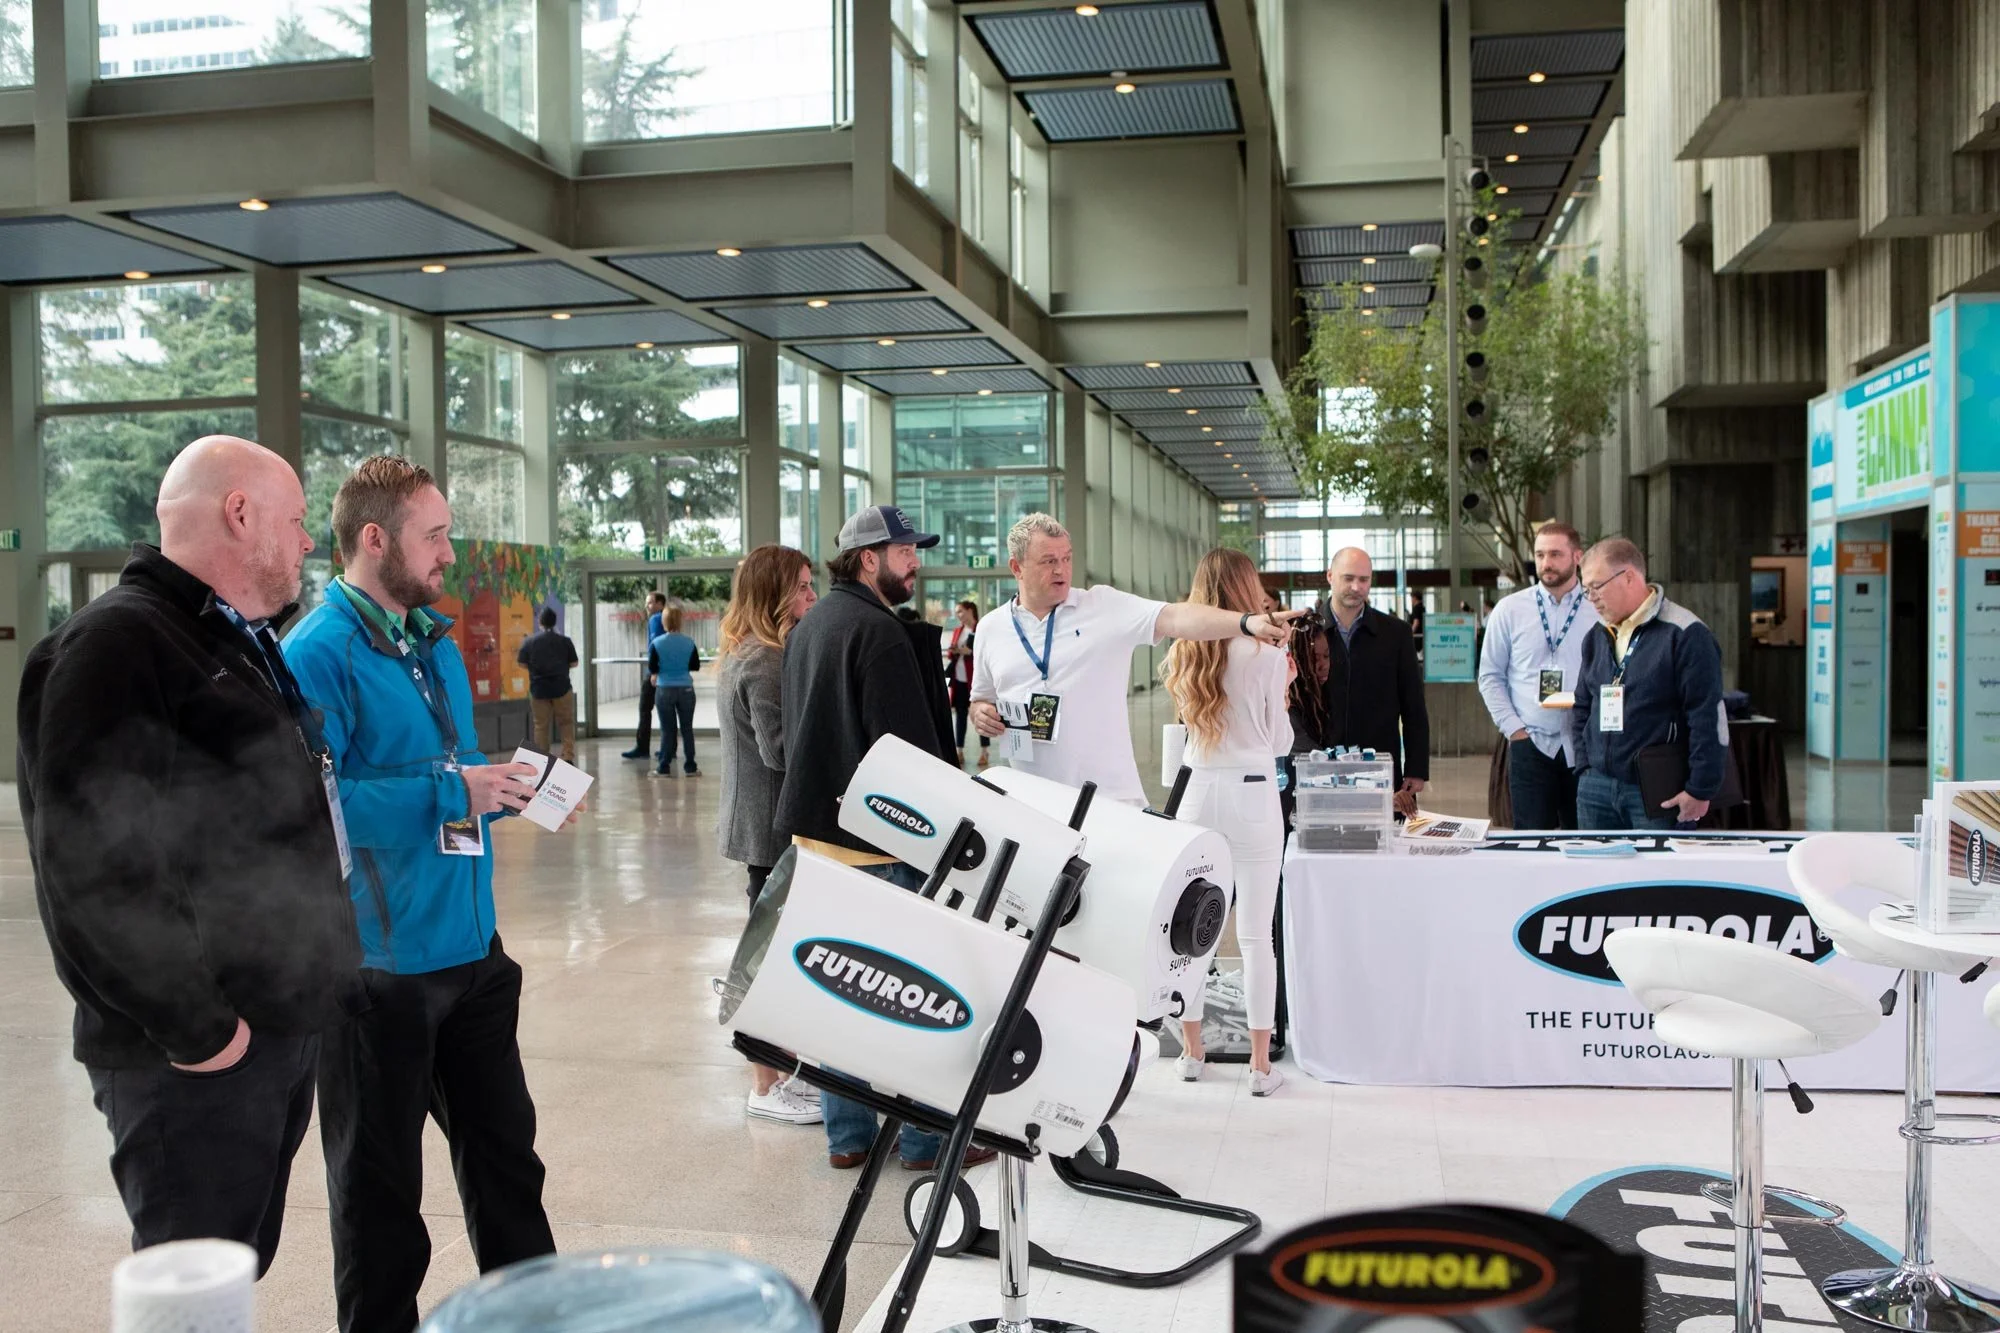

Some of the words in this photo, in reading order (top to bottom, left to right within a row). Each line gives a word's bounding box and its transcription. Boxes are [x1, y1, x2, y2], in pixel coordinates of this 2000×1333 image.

[650, 545, 669, 561] EXIT
[973, 555, 989, 568] EXIT
[869, 797, 931, 835] FUTUROLA
[1185, 864, 1214, 878] FUTUROLA
[1971, 832, 1981, 883] FUTUROLA
[803, 944, 959, 1025] FUTUROLA
[836, 983, 916, 1020] AMSTERDAM
[1526, 1011, 1572, 1028] THE
[1583, 1044, 1716, 1059] FUTUROLAU
[1303, 1251, 1511, 1290] FUTUROLA
